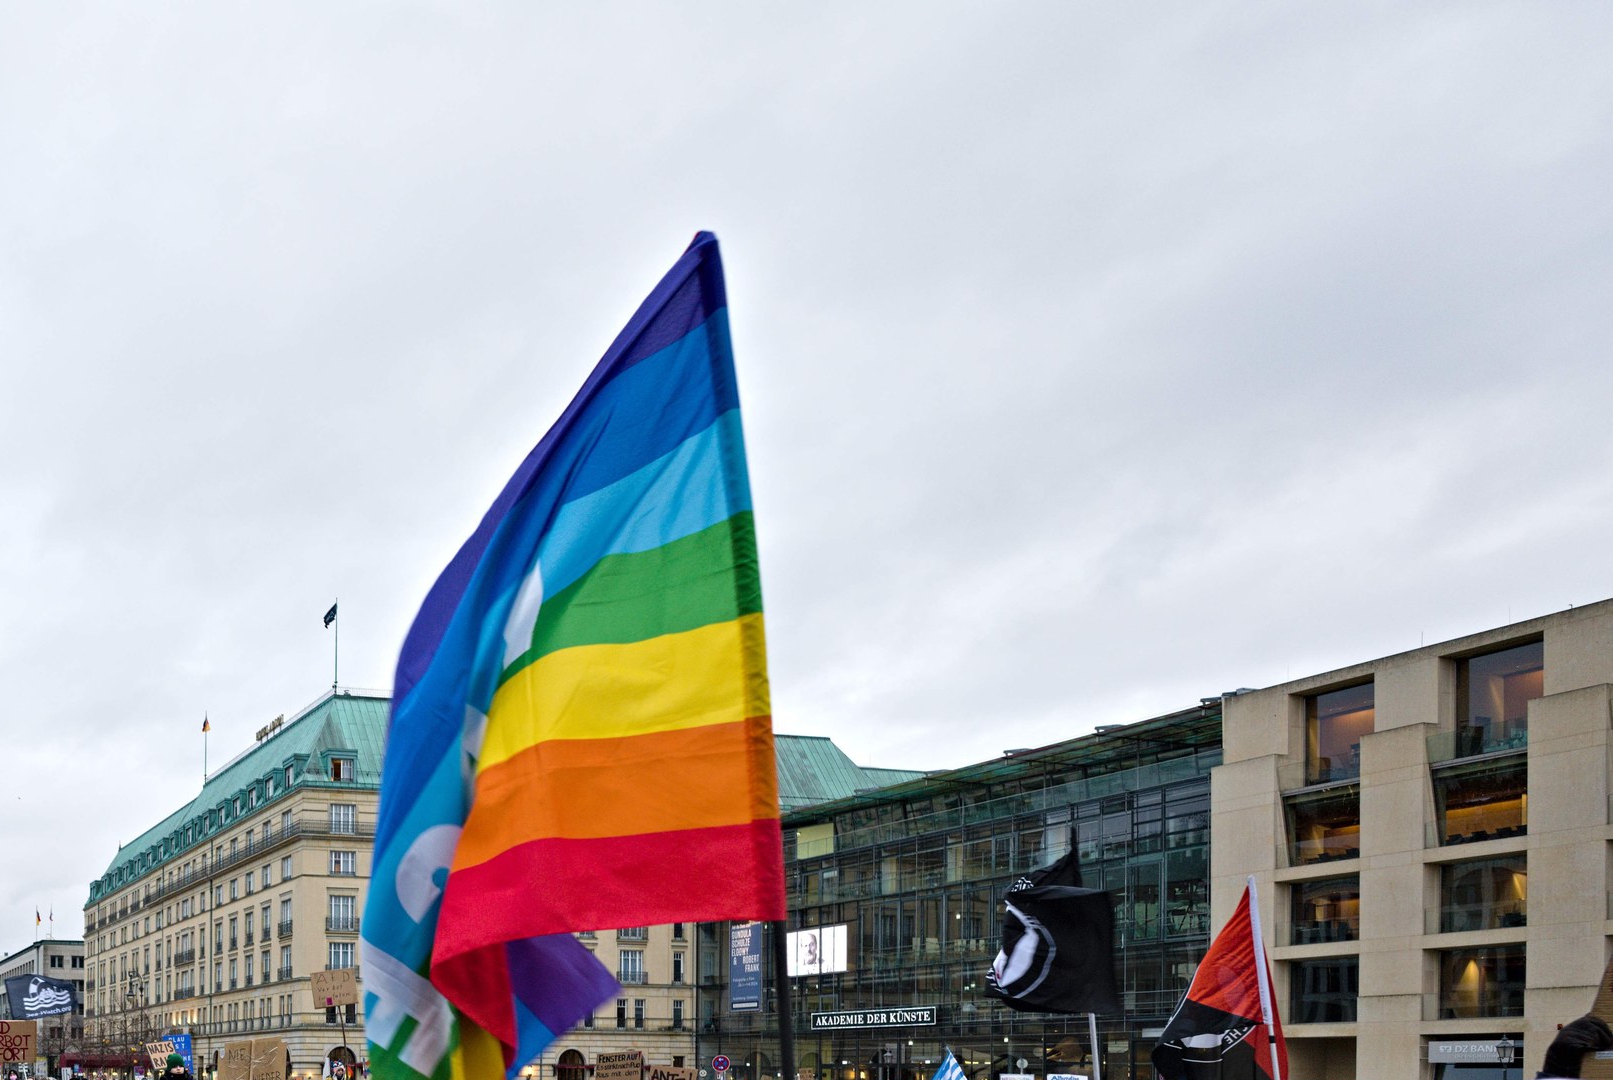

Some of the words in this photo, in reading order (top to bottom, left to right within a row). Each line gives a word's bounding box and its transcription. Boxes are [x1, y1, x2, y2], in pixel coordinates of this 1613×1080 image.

[745, 964, 760, 973] FRANK
[816, 1014, 864, 1026] AKADEMIE
[867, 1013, 887, 1024] DER
[889, 1011, 931, 1023] KÜNSTE
[148, 1043, 173, 1054] NAZIS
[1455, 1045, 1468, 1053] DZ
[228, 1048, 246, 1063] NIE
[598, 1054, 626, 1064] FENSTER
